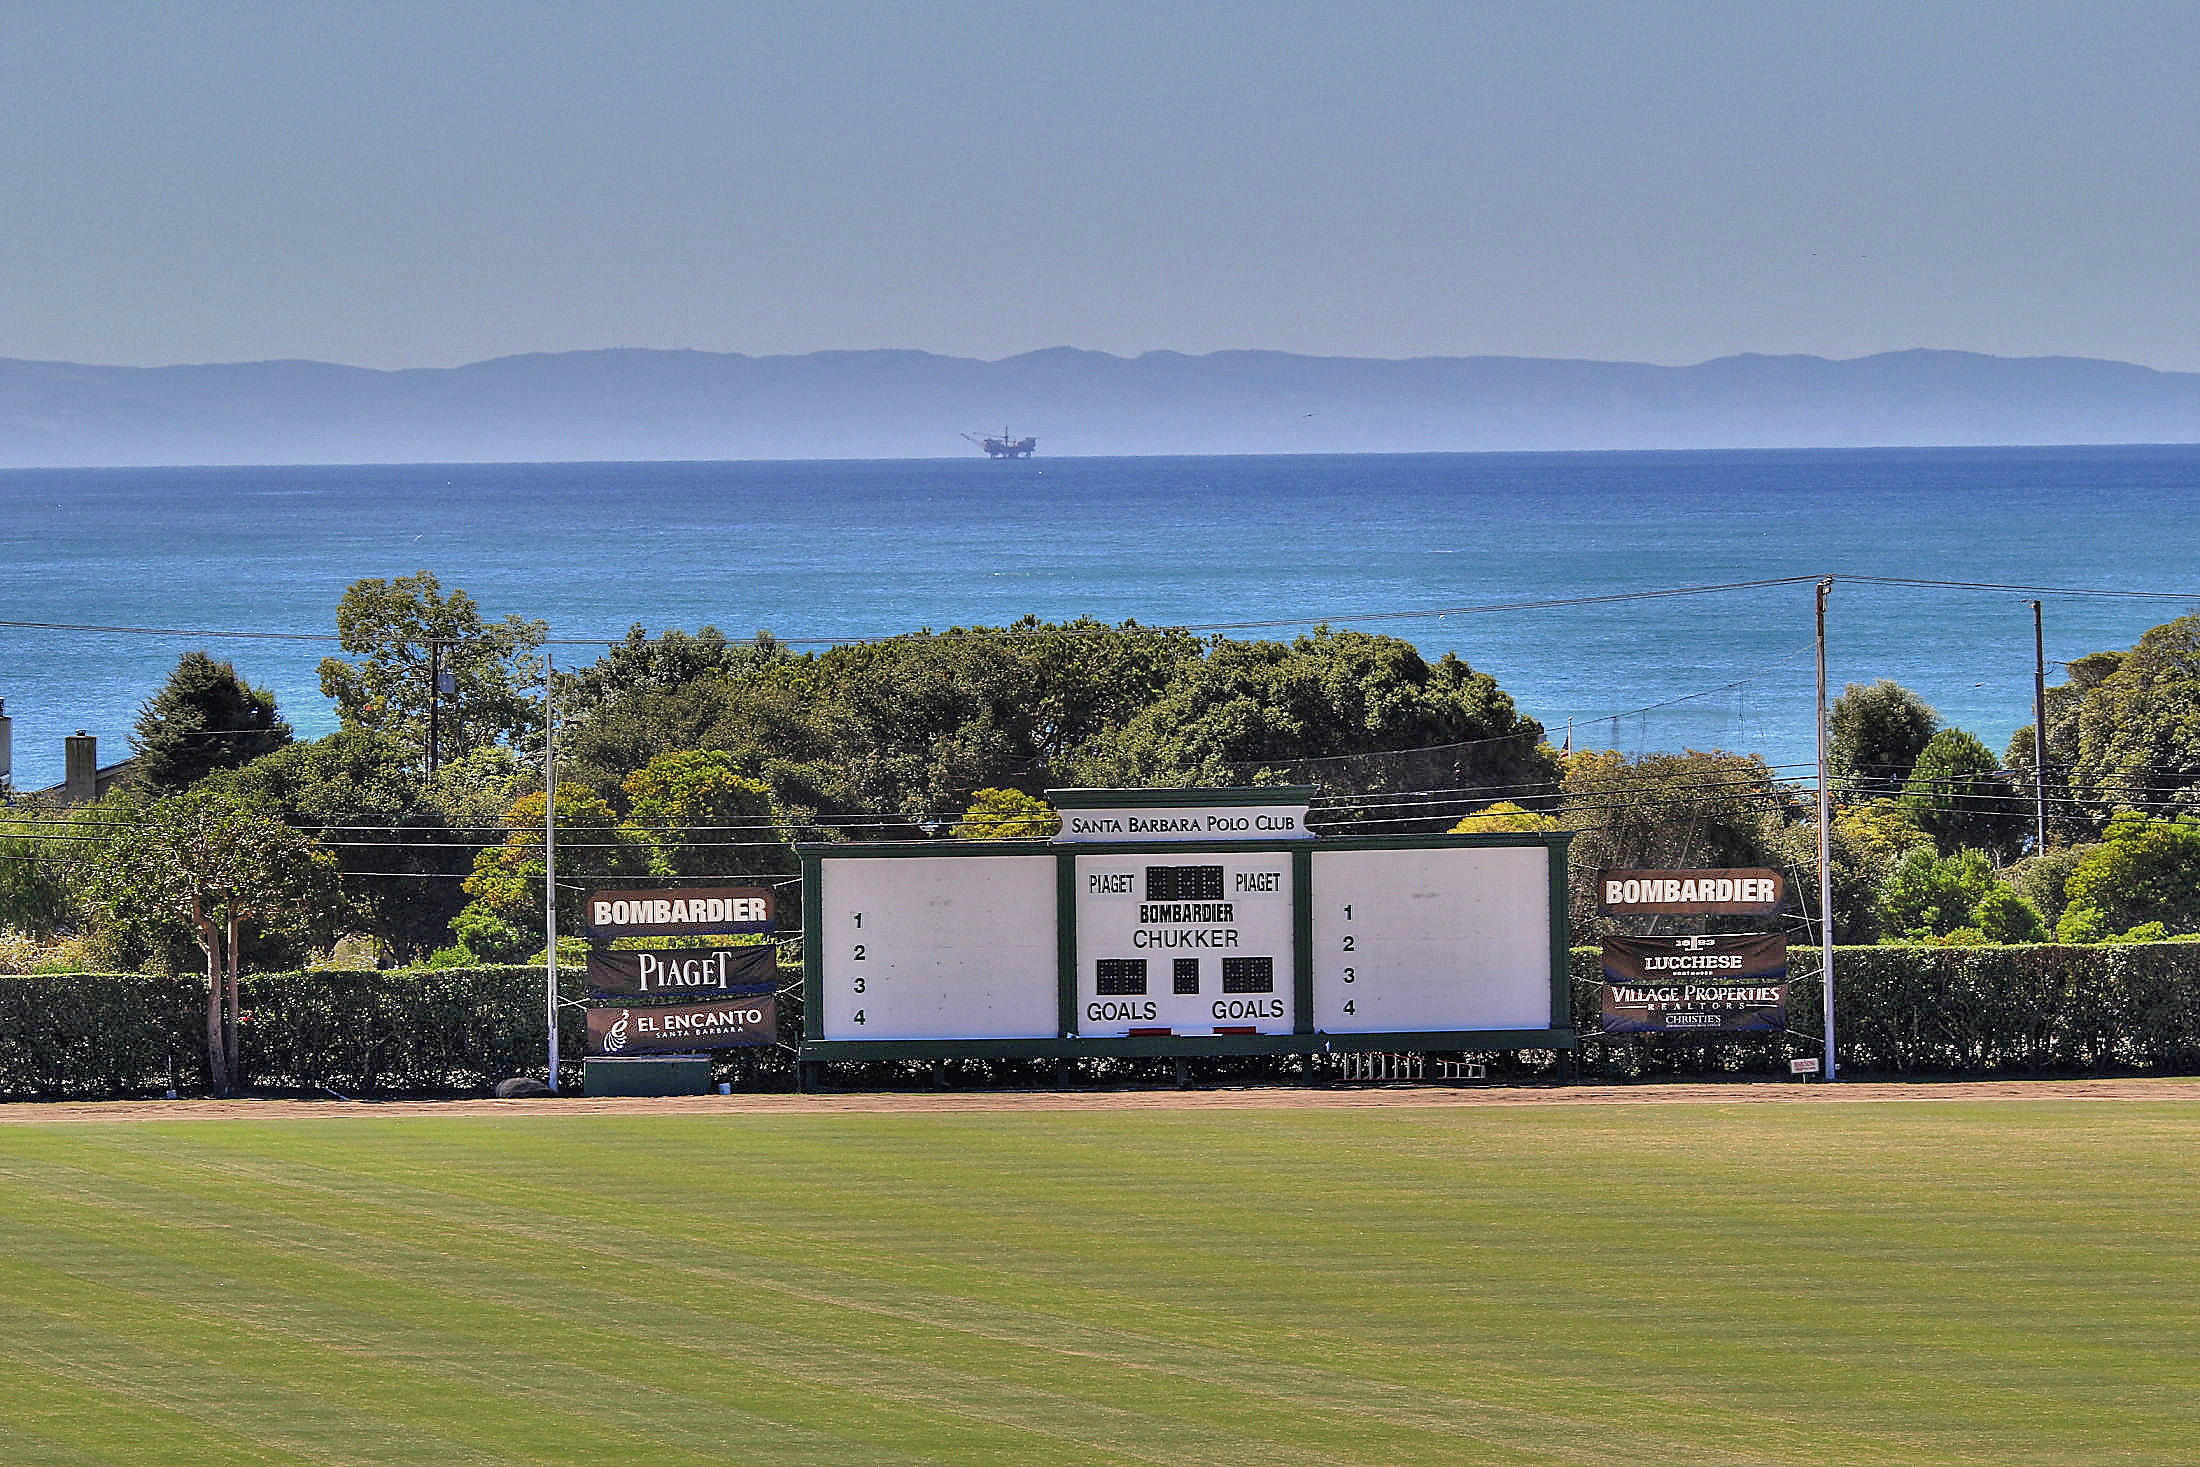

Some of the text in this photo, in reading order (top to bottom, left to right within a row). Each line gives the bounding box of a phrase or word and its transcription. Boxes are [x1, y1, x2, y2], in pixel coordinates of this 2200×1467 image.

[1071, 815, 1295, 834] SANTA BARBARA POLO CLUB
[1089, 874, 1134, 893] PIAGET
[1236, 873, 1281, 892] PIAGET
[1605, 879, 1775, 904] BOMBARDIER
[593, 897, 767, 926] BOMBARDIER
[853, 912, 862, 929] 1
[1140, 904, 1234, 923] BOMBARDIER
[1344, 904, 1353, 920] 1
[1133, 930, 1239, 948] CHUKKER
[1343, 935, 1355, 952] 2
[853, 944, 866, 961] 2
[637, 951, 732, 991] PIAGET
[1644, 955, 1743, 970] LUCCHESE
[1343, 967, 1355, 984] 3
[853, 977, 866, 994] 3
[1611, 984, 1780, 1003] VILLAGE PROPERTIES
[1087, 1001, 1157, 1021] GOALS
[1212, 999, 1284, 1019] GOALS
[1343, 999, 1355, 1016] 4
[1647, 1002, 1745, 1010] REALTORS
[637, 1009, 763, 1032] EL ENCANTO
[853, 1009, 866, 1026] 4
